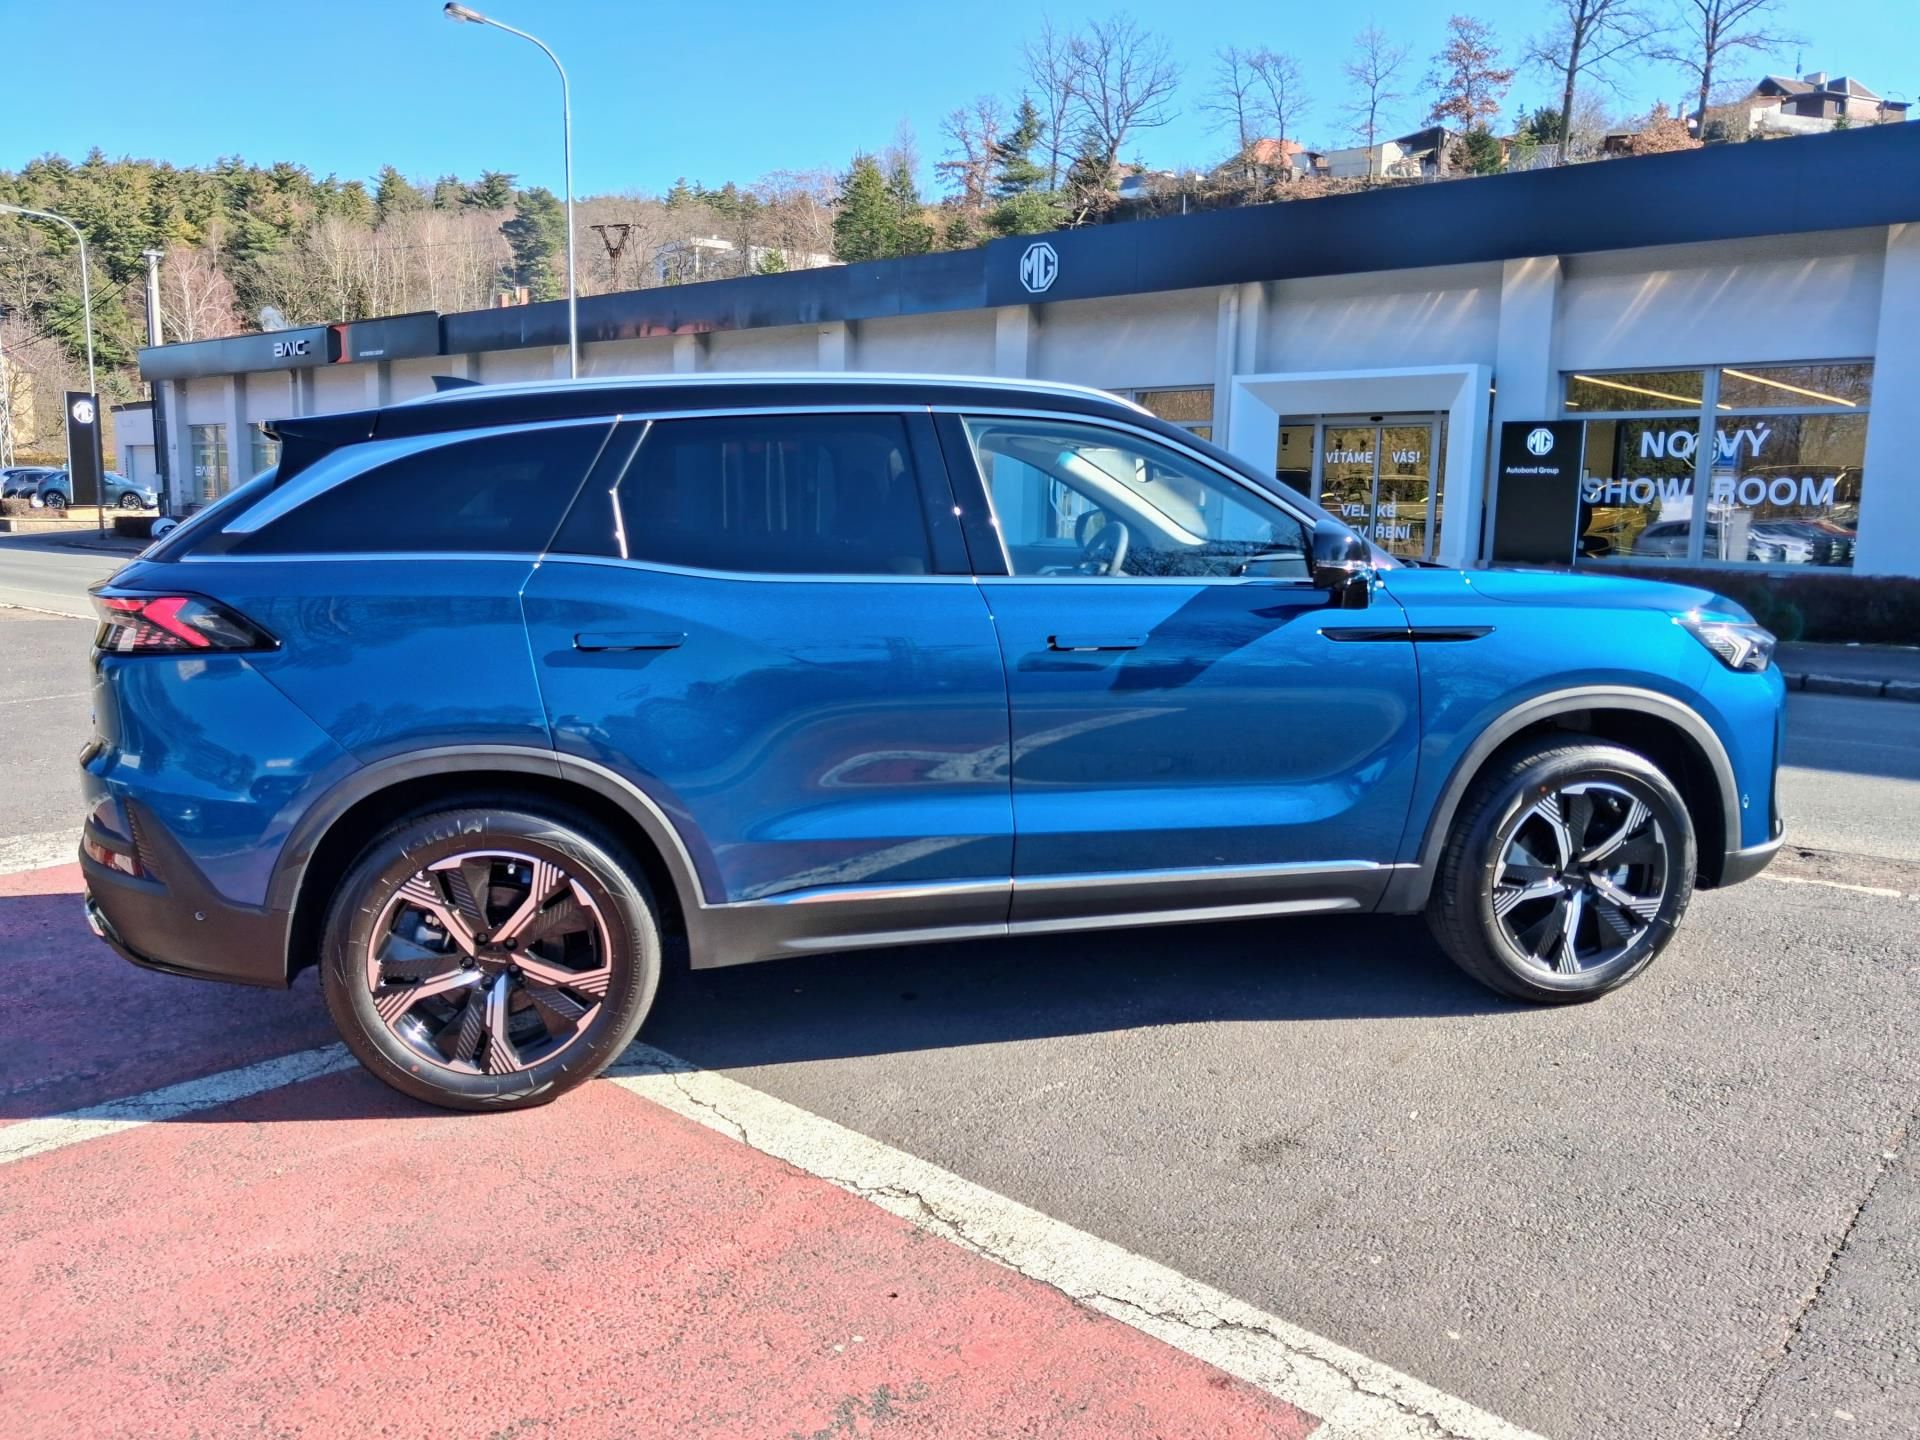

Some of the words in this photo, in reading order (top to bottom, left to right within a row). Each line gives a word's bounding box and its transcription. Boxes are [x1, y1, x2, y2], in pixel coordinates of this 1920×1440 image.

[1021, 243, 1057, 292] MG
[274, 340, 305, 357] BAIC
[73, 401, 95, 424] MG
[1528, 429, 1553, 455] MG
[1326, 449, 1373, 464] VÍTÁME
[1392, 448, 1421, 463] VÁS!
[1506, 466, 1538, 474] Autobond
[1538, 467, 1560, 475] Group
[1582, 477, 1692, 505] SHOW
[1712, 477, 1837, 506] ROOM
